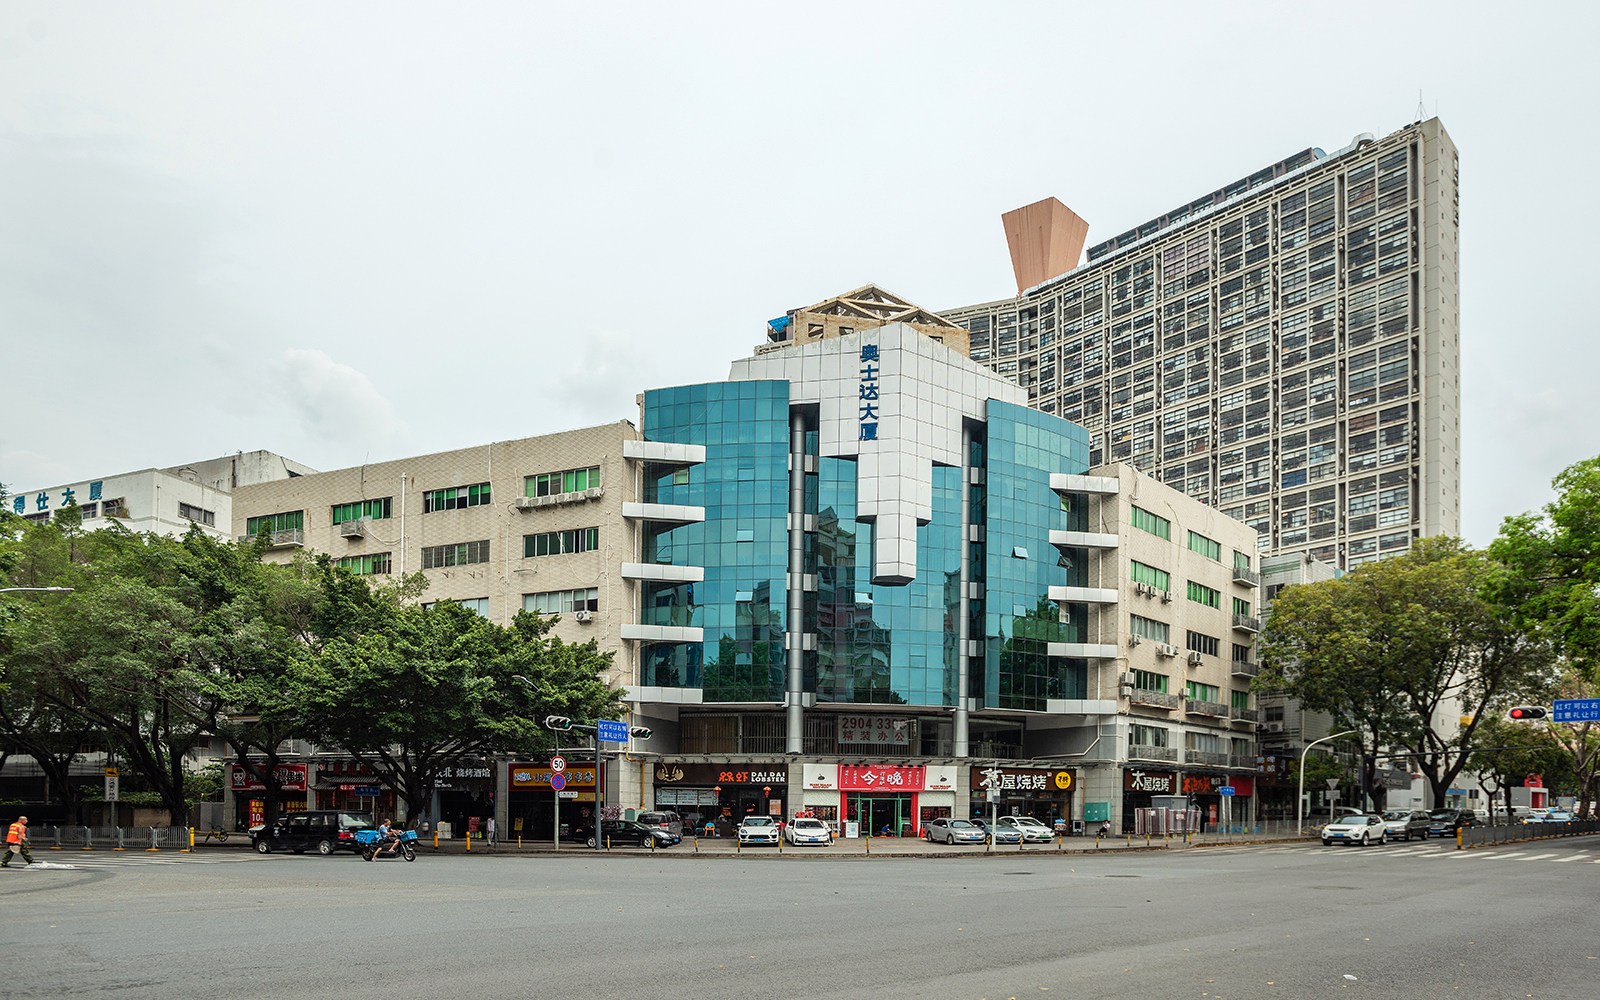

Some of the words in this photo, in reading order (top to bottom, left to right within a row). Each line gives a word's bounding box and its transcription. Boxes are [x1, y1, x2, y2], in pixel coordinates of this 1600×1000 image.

[859, 344, 880, 441] 奥士达大厦
[842, 717, 873, 729] 2904
[842, 730, 905, 742] 精装办公
[554, 760, 564, 769] 50
[1131, 770, 1170, 792] 木屋烧烤
